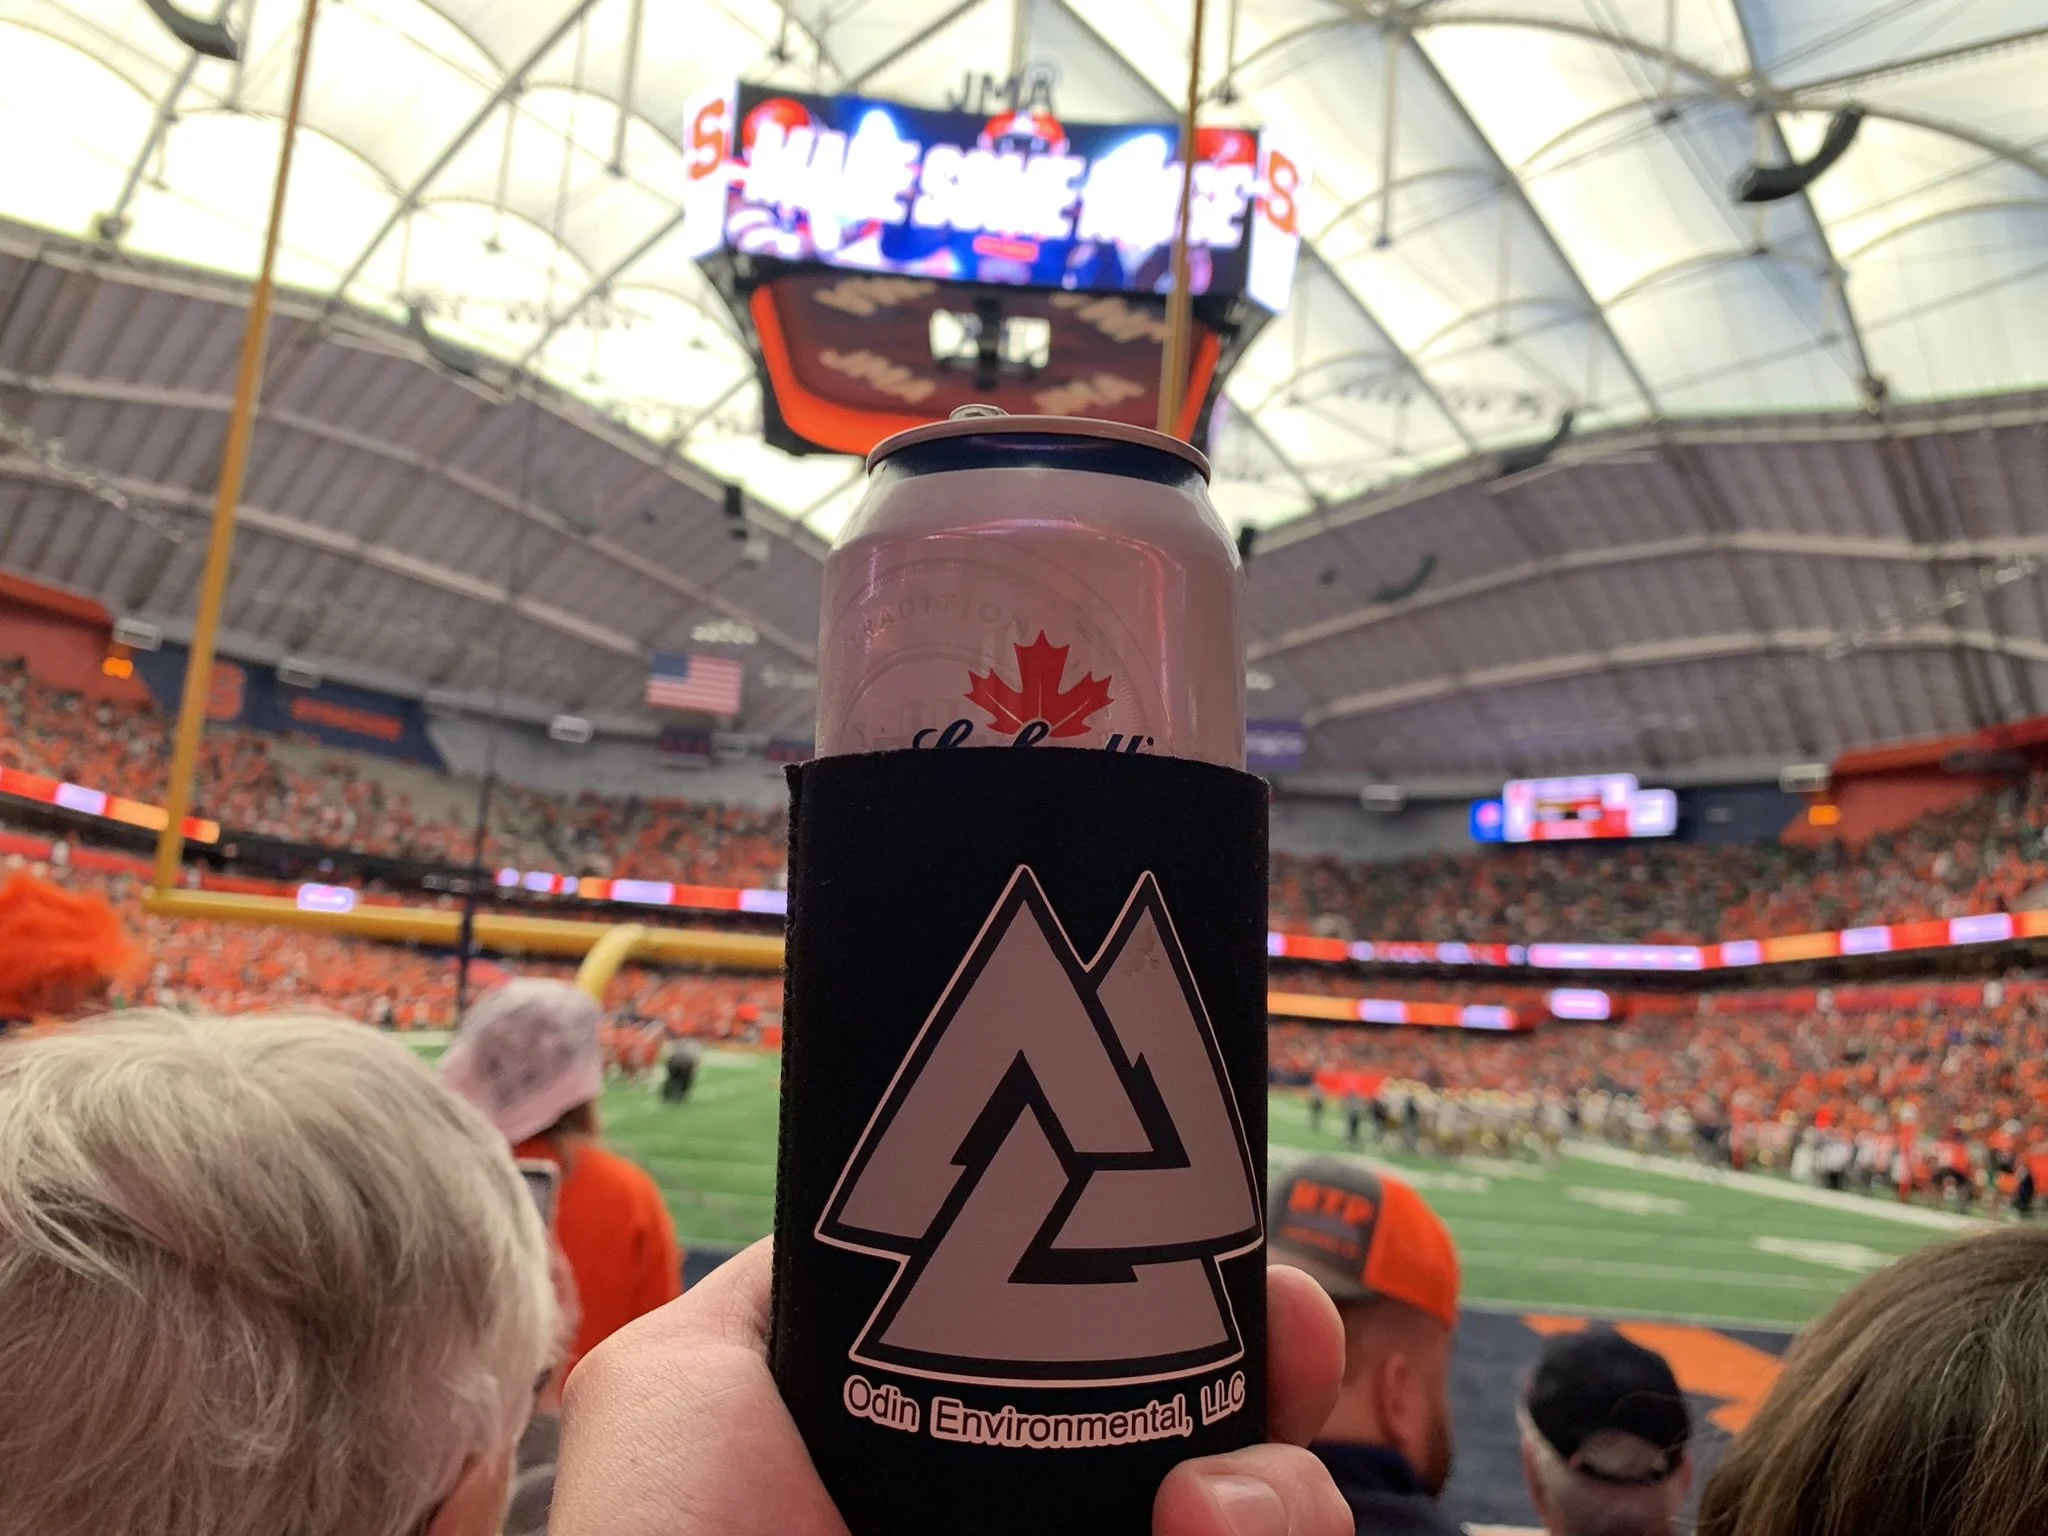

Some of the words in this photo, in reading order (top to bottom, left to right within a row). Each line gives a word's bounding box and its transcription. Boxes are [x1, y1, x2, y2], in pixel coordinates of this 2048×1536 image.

[688, 98, 725, 180] S
[742, 120, 922, 224] MAE
[1264, 149, 1299, 235] S
[846, 1377, 919, 1431] Odin
[932, 1395, 1192, 1446] Environmental,
[1200, 1372, 1245, 1426] LLC
